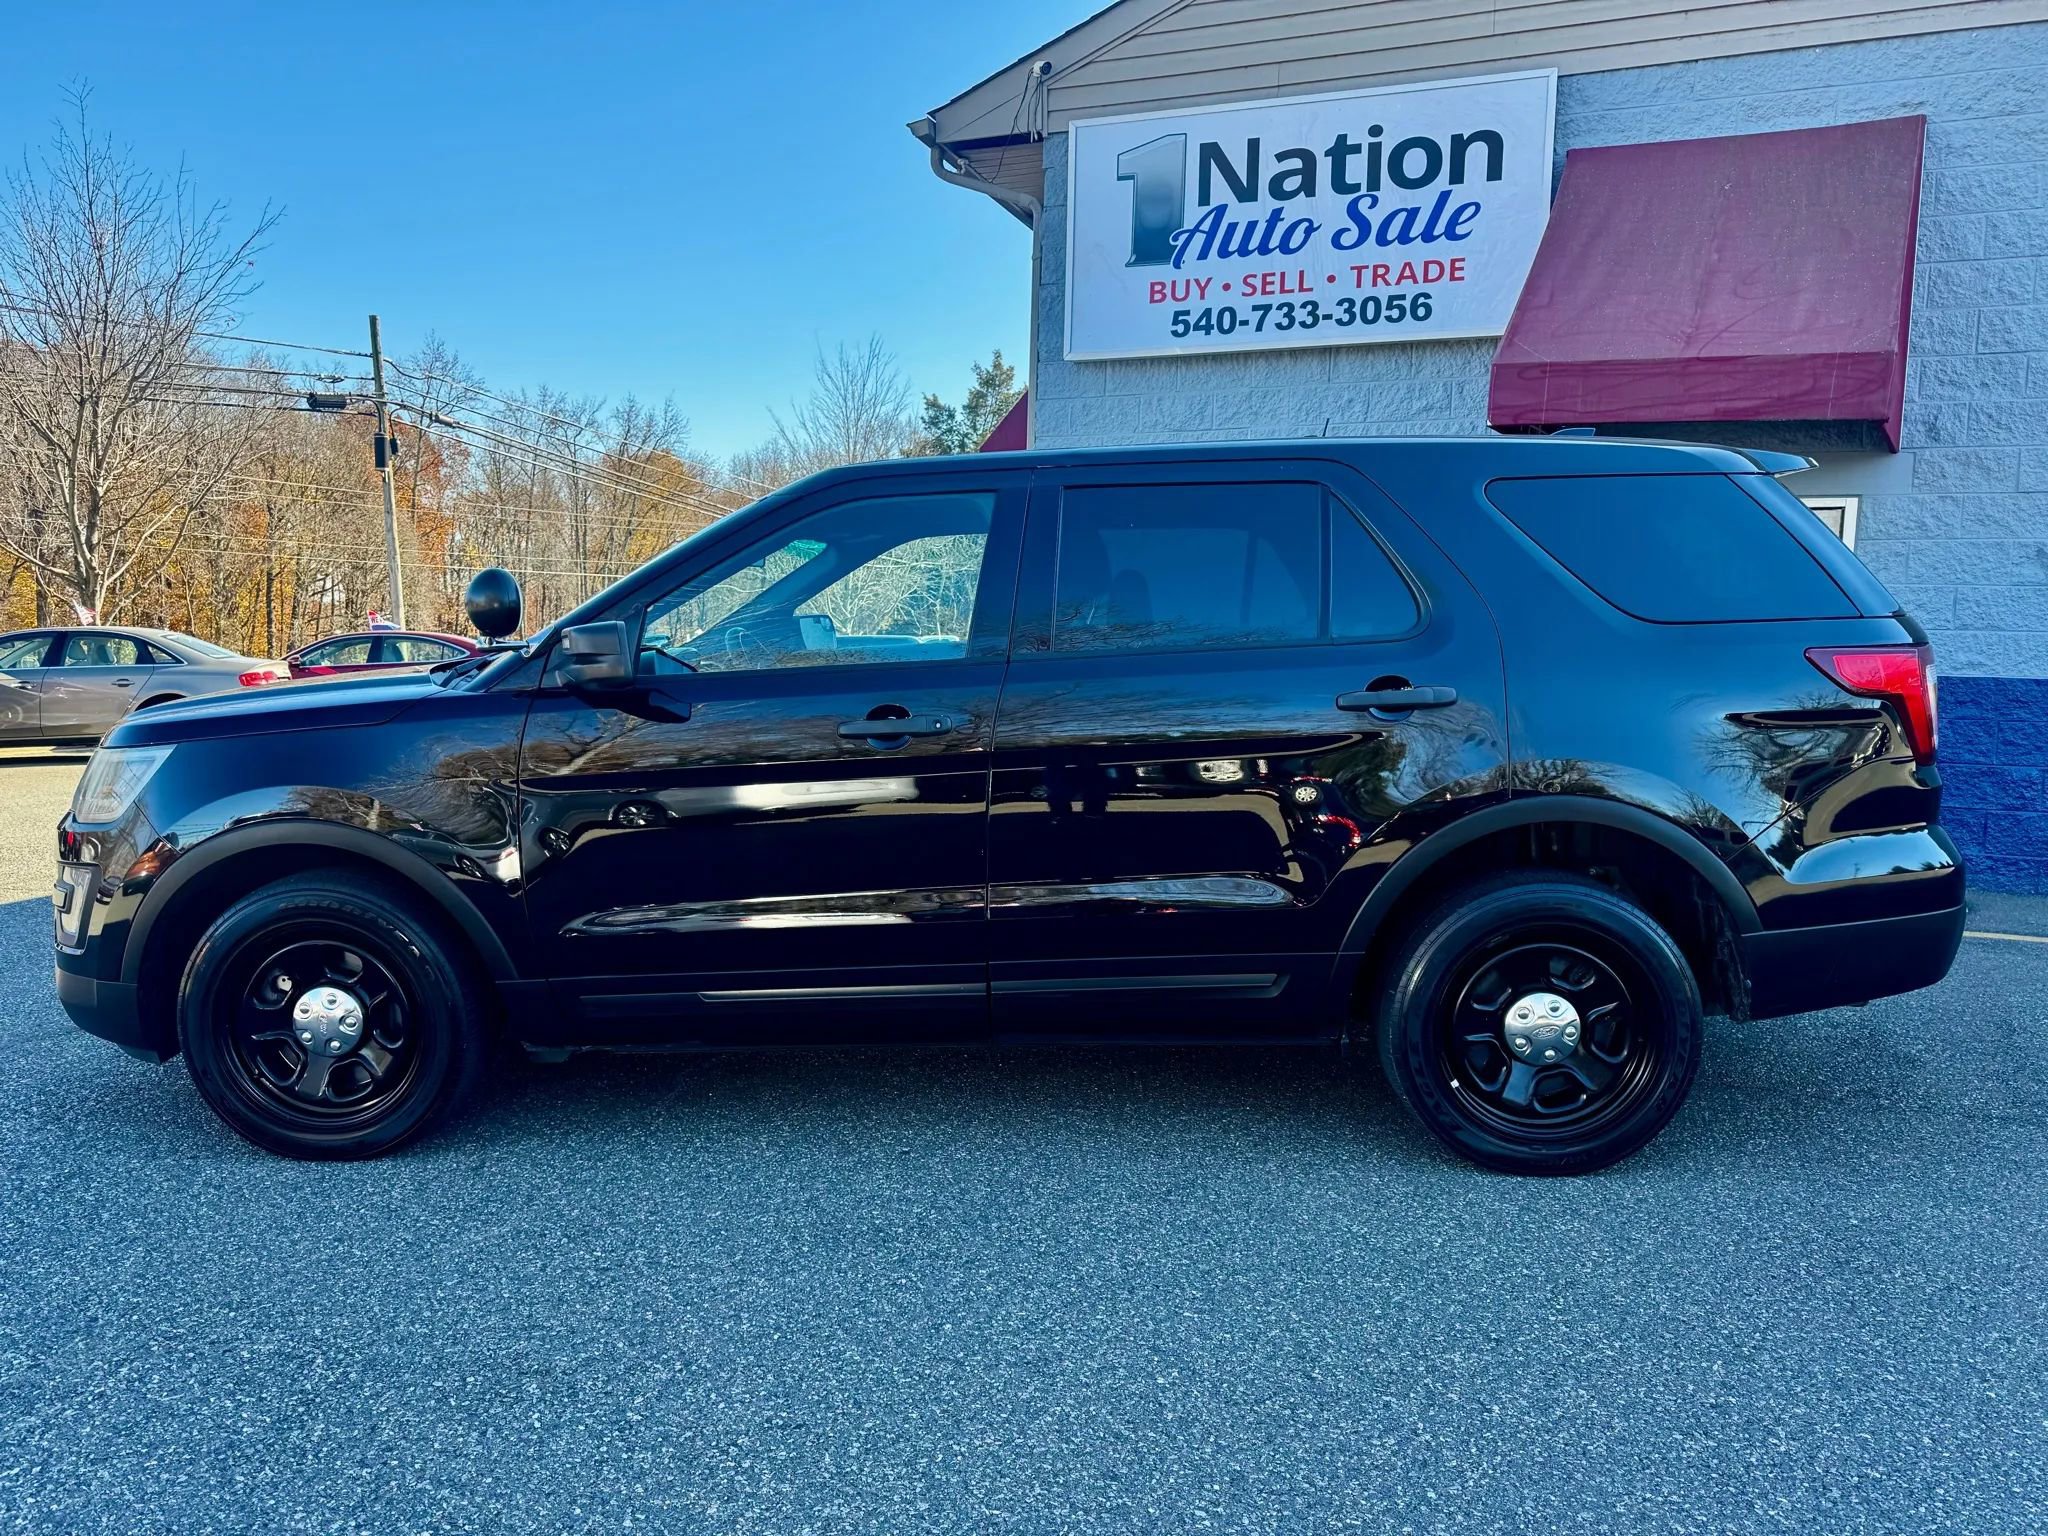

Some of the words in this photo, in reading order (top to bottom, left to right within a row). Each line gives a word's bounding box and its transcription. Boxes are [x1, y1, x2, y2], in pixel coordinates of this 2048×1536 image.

[1197, 123, 1505, 208] Nation
[1170, 201, 1322, 270] Auto
[1330, 189, 1482, 251] Sale
[1148, 277, 1213, 304] BUY
[1241, 269, 1314, 297] SELL
[1350, 257, 1467, 289] TRADE
[1170, 291, 1434, 338] 540-733-3056
